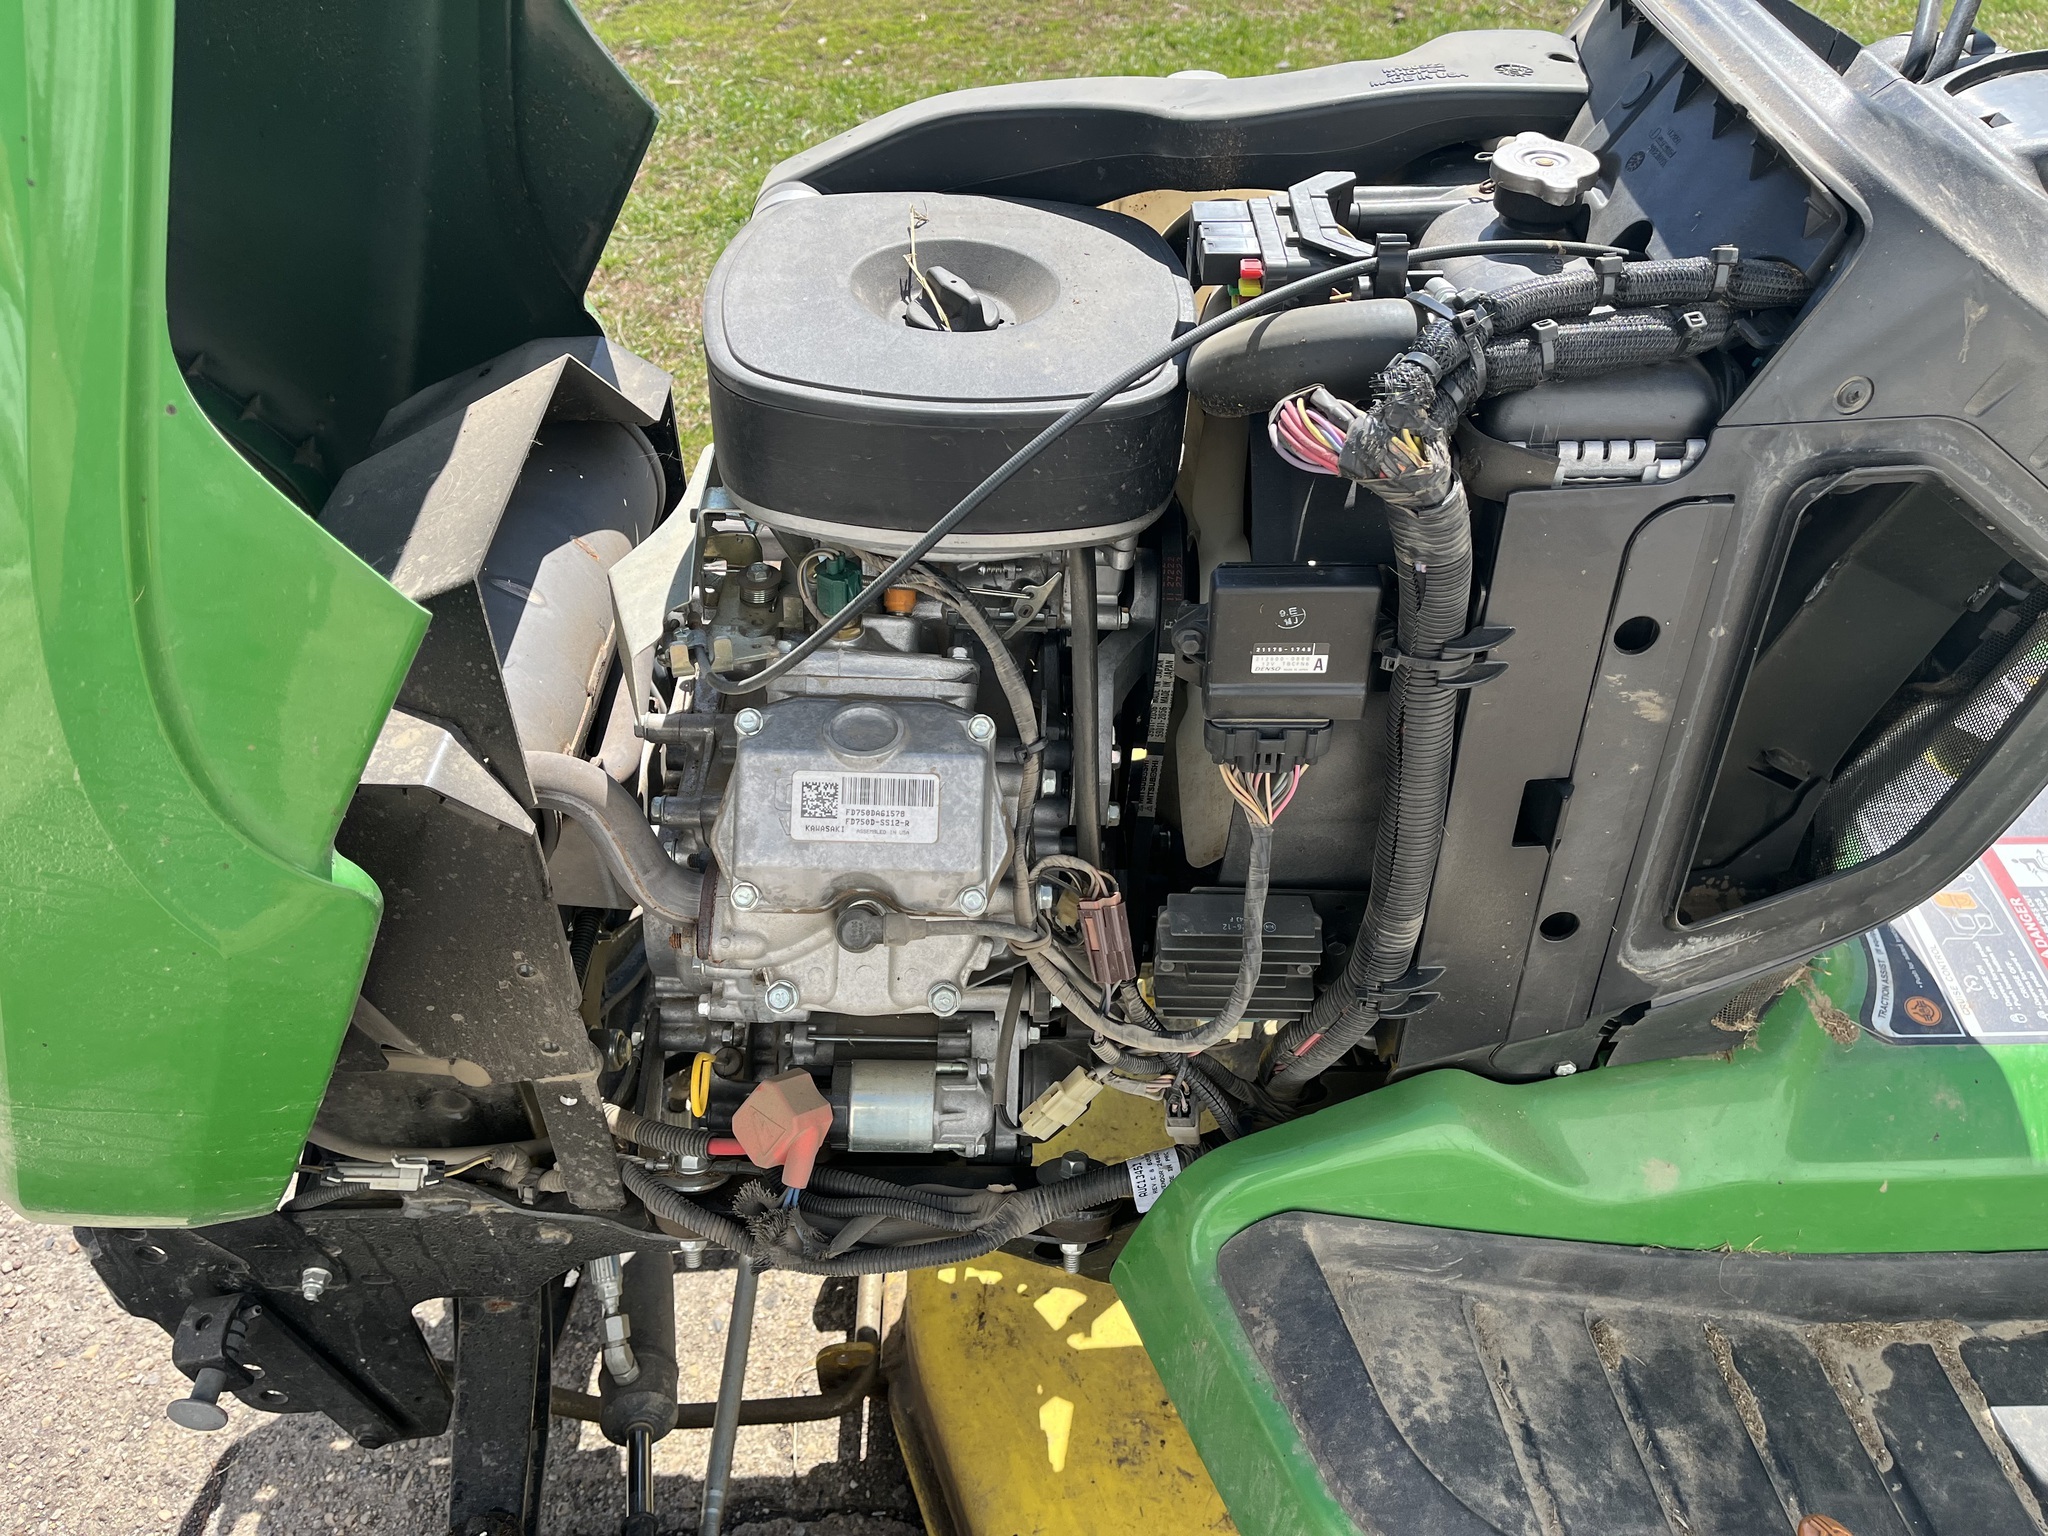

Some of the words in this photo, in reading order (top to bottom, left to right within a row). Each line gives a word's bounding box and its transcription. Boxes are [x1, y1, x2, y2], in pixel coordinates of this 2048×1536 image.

[1164, 660, 1174, 679] JAPAN
[1313, 658, 1323, 671] A
[1160, 689, 1170, 704] MADE
[1146, 760, 1159, 805] MITSUBOSHI
[805, 824, 845, 833] KAWASAKI
[845, 818, 910, 827] FD750D-SS12-R
[2010, 897, 2048, 948] DANGER
[1878, 959, 1889, 985] ASSIST
[1930, 944, 1953, 982] CONTROL
[1976, 965, 1986, 975] ON
[2005, 961, 2017, 974] OFF
[1982, 975, 1999, 999] CRUISE
[2012, 974, 2029, 998] CRUISE
[1878, 985, 1890, 1018] TRACTION
[1950, 985, 1970, 1015] CRUISE
